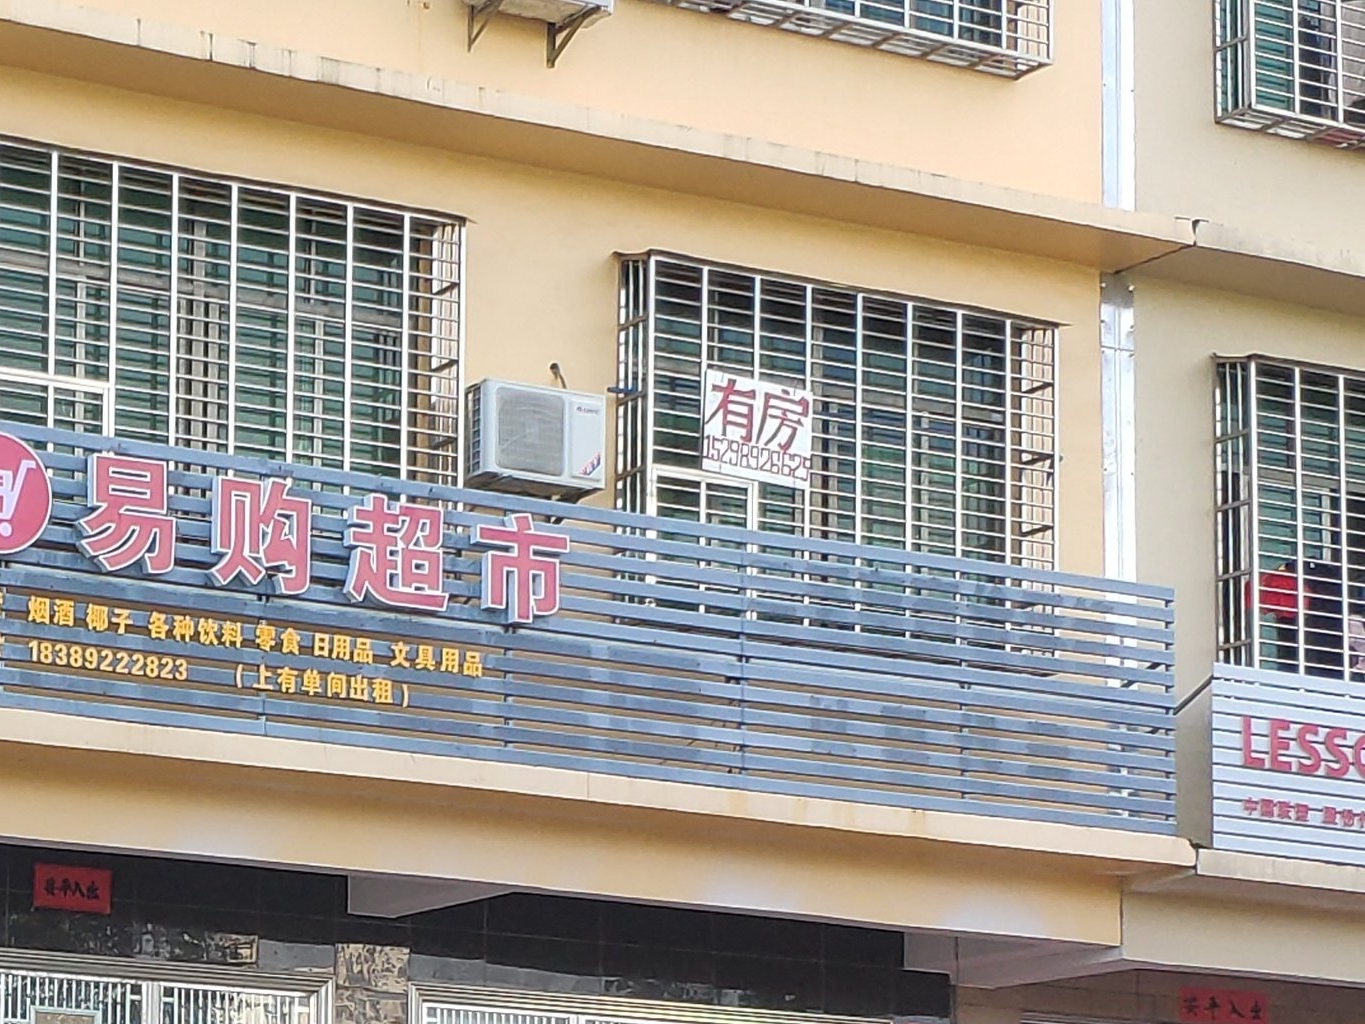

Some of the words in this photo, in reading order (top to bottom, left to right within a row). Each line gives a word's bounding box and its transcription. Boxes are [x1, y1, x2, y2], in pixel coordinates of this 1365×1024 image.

[704, 378, 810, 452] 有房
[76, 453, 572, 624] 易购超市
[28, 596, 75, 627] 烟酒
[86, 603, 134, 634] 椰子
[148, 611, 243, 648] 各种饮料
[255, 623, 301, 655] 零食
[313, 632, 374, 665] 日用品
[390, 640, 483, 677] 文具用品
[28, 640, 188, 681] 18389222823
